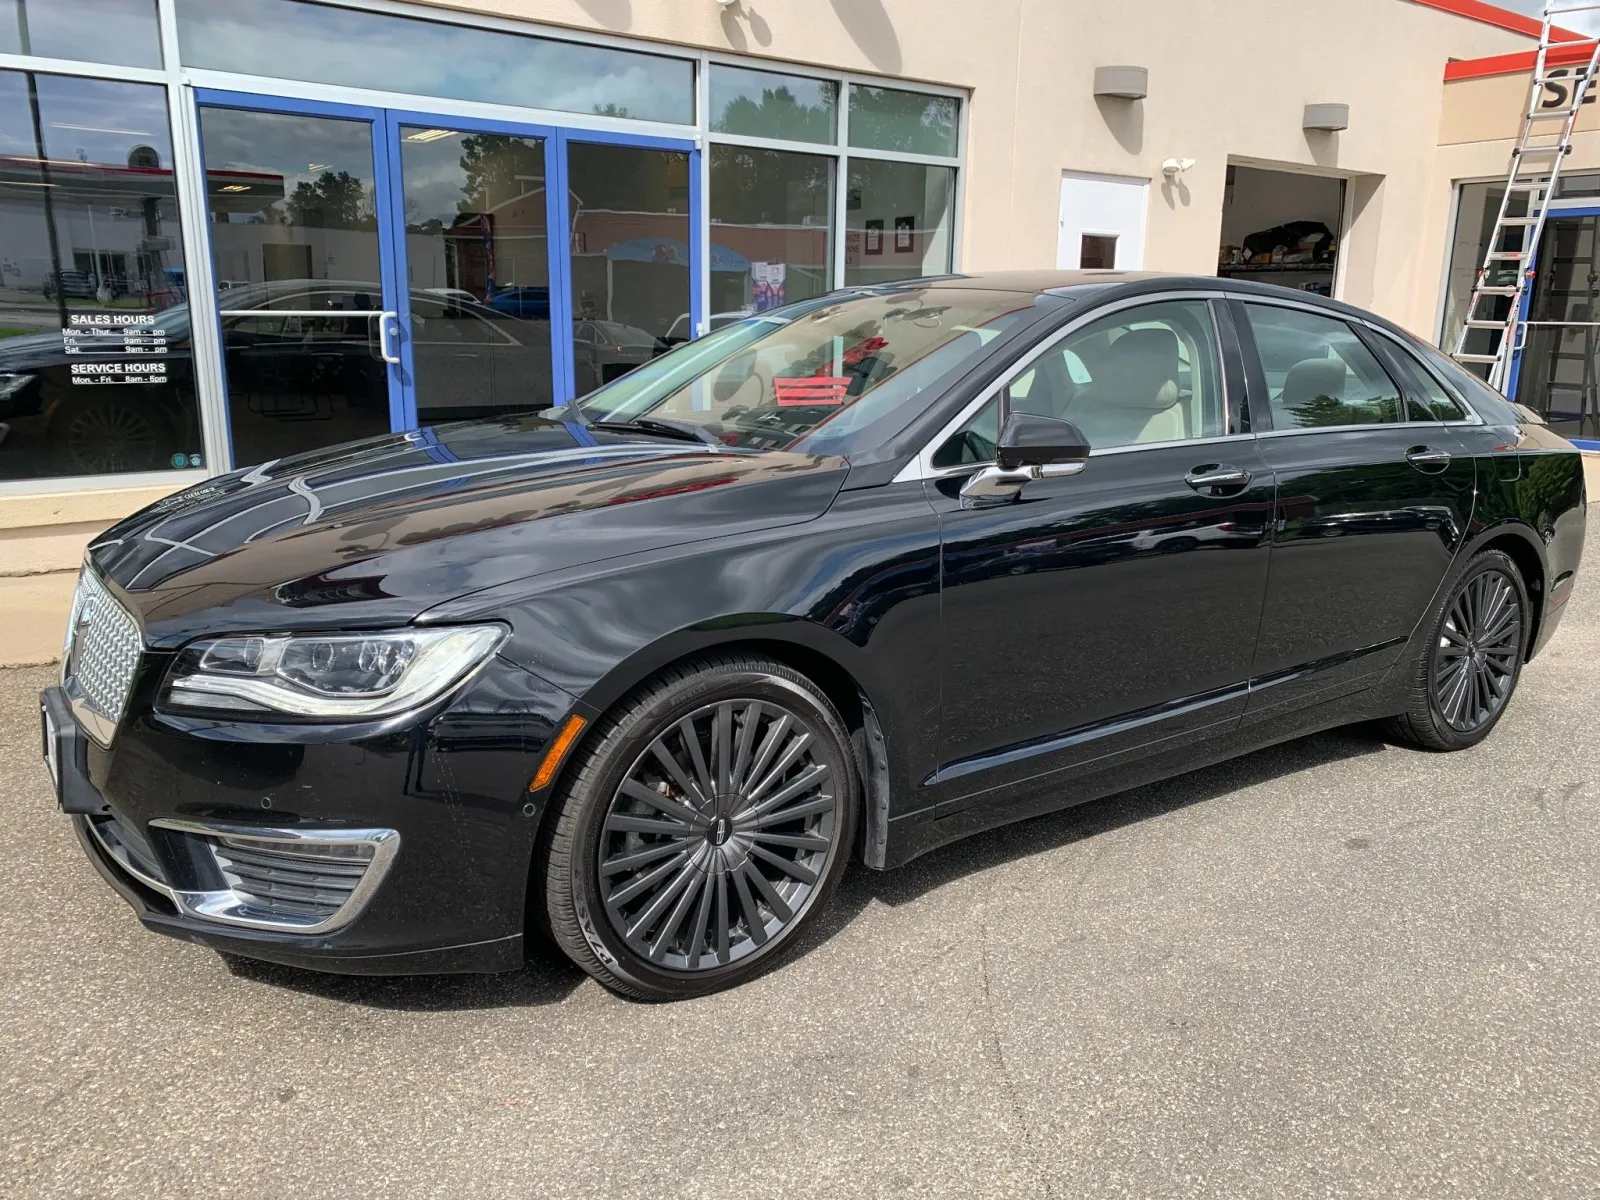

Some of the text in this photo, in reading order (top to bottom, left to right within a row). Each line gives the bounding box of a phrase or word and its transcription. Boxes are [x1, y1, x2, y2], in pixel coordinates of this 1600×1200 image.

[71, 315, 154, 324] SALES HOURS
[65, 346, 81, 354] Sat.
[71, 363, 166, 373] SERVICE HOURS
[72, 376, 93, 384] Mon.
[150, 375, 167, 383] 6pm
